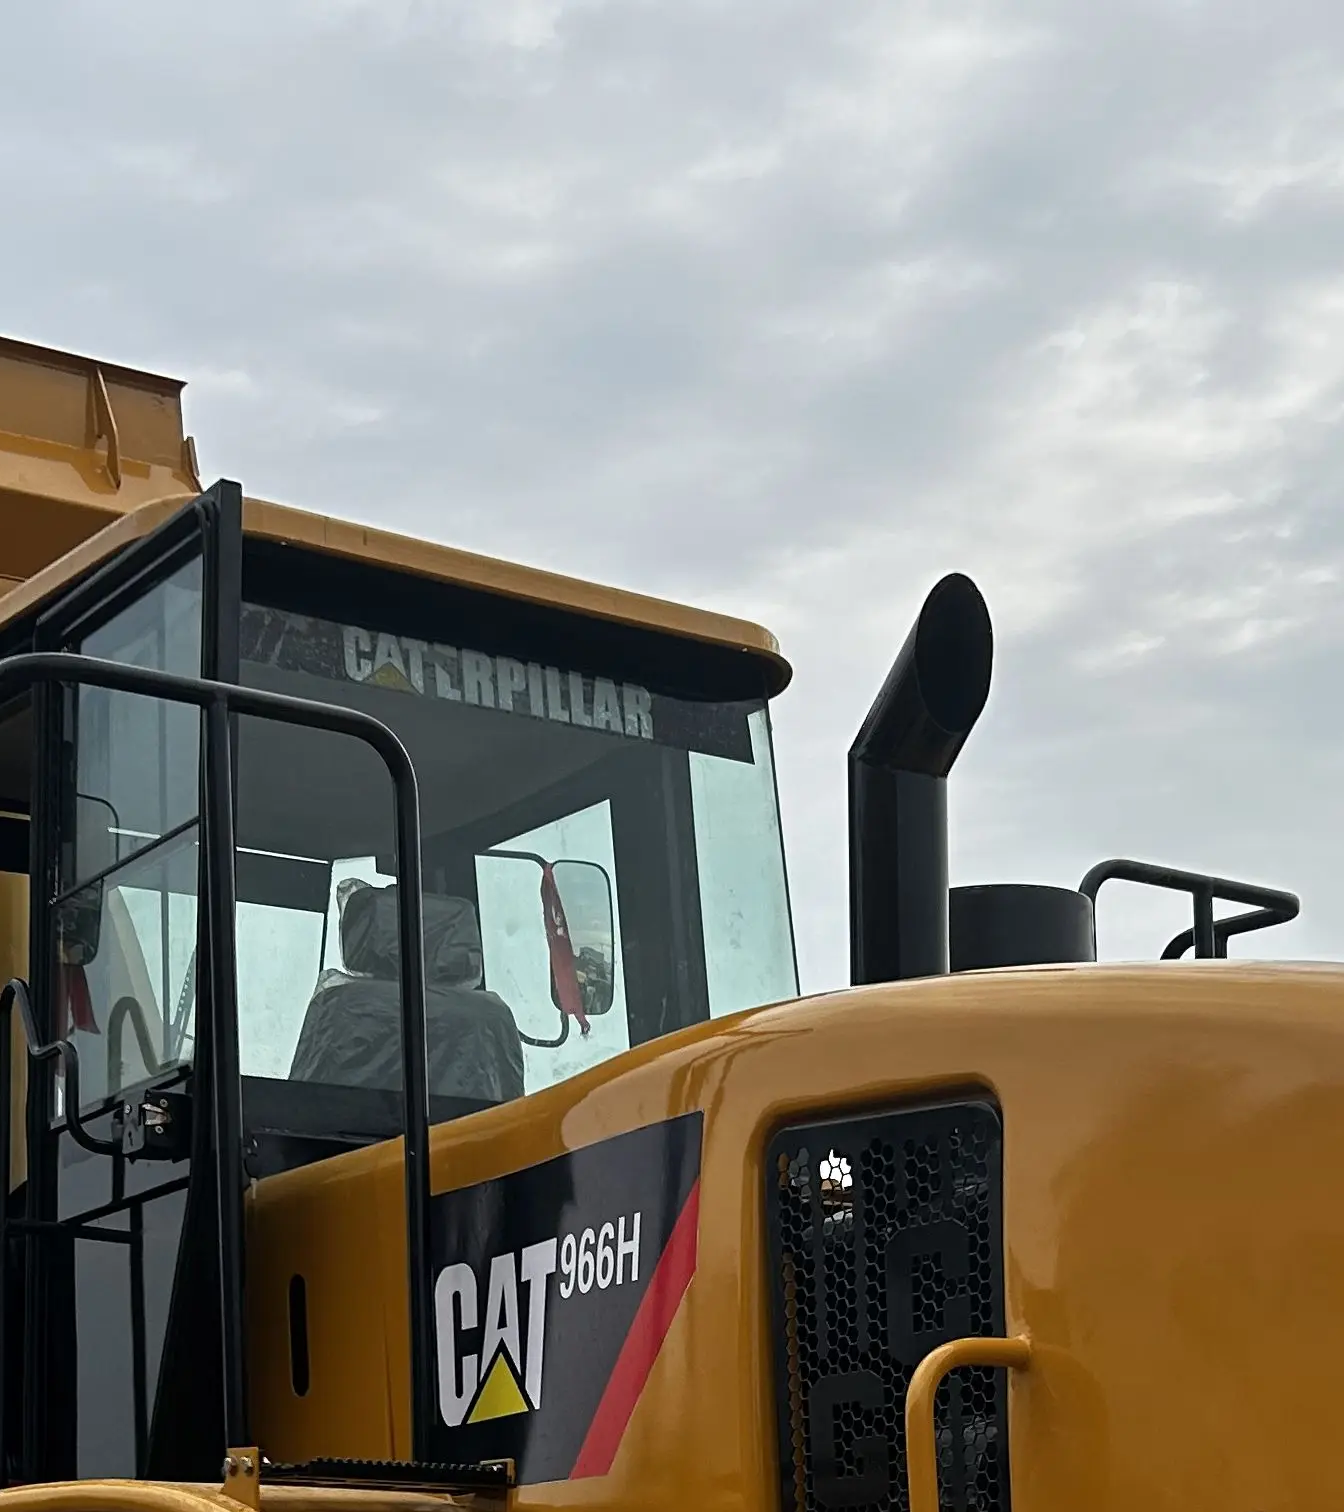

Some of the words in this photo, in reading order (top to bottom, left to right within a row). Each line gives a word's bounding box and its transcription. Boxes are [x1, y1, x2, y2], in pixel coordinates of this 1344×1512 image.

[342, 625, 654, 740] CATERPILLAR
[434, 1237, 557, 1428] CAT
[559, 1211, 641, 1299] 966H
